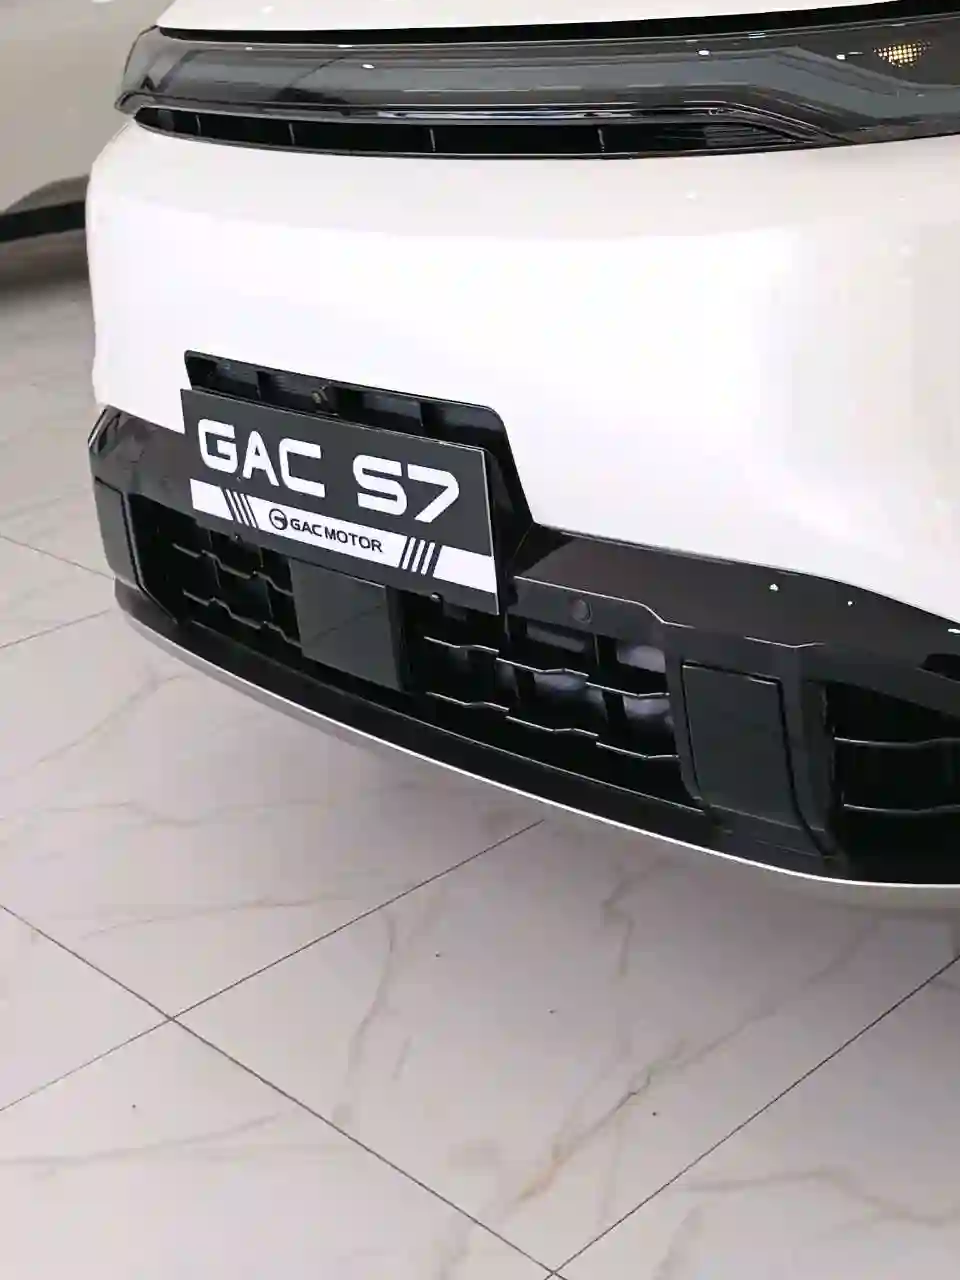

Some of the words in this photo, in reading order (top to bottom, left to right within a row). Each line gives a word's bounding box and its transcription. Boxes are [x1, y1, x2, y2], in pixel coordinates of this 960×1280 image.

[198, 418, 325, 498] GAC
[353, 454, 460, 523] S7
[290, 518, 322, 537] GAC
[324, 526, 382, 553] MOTOR
